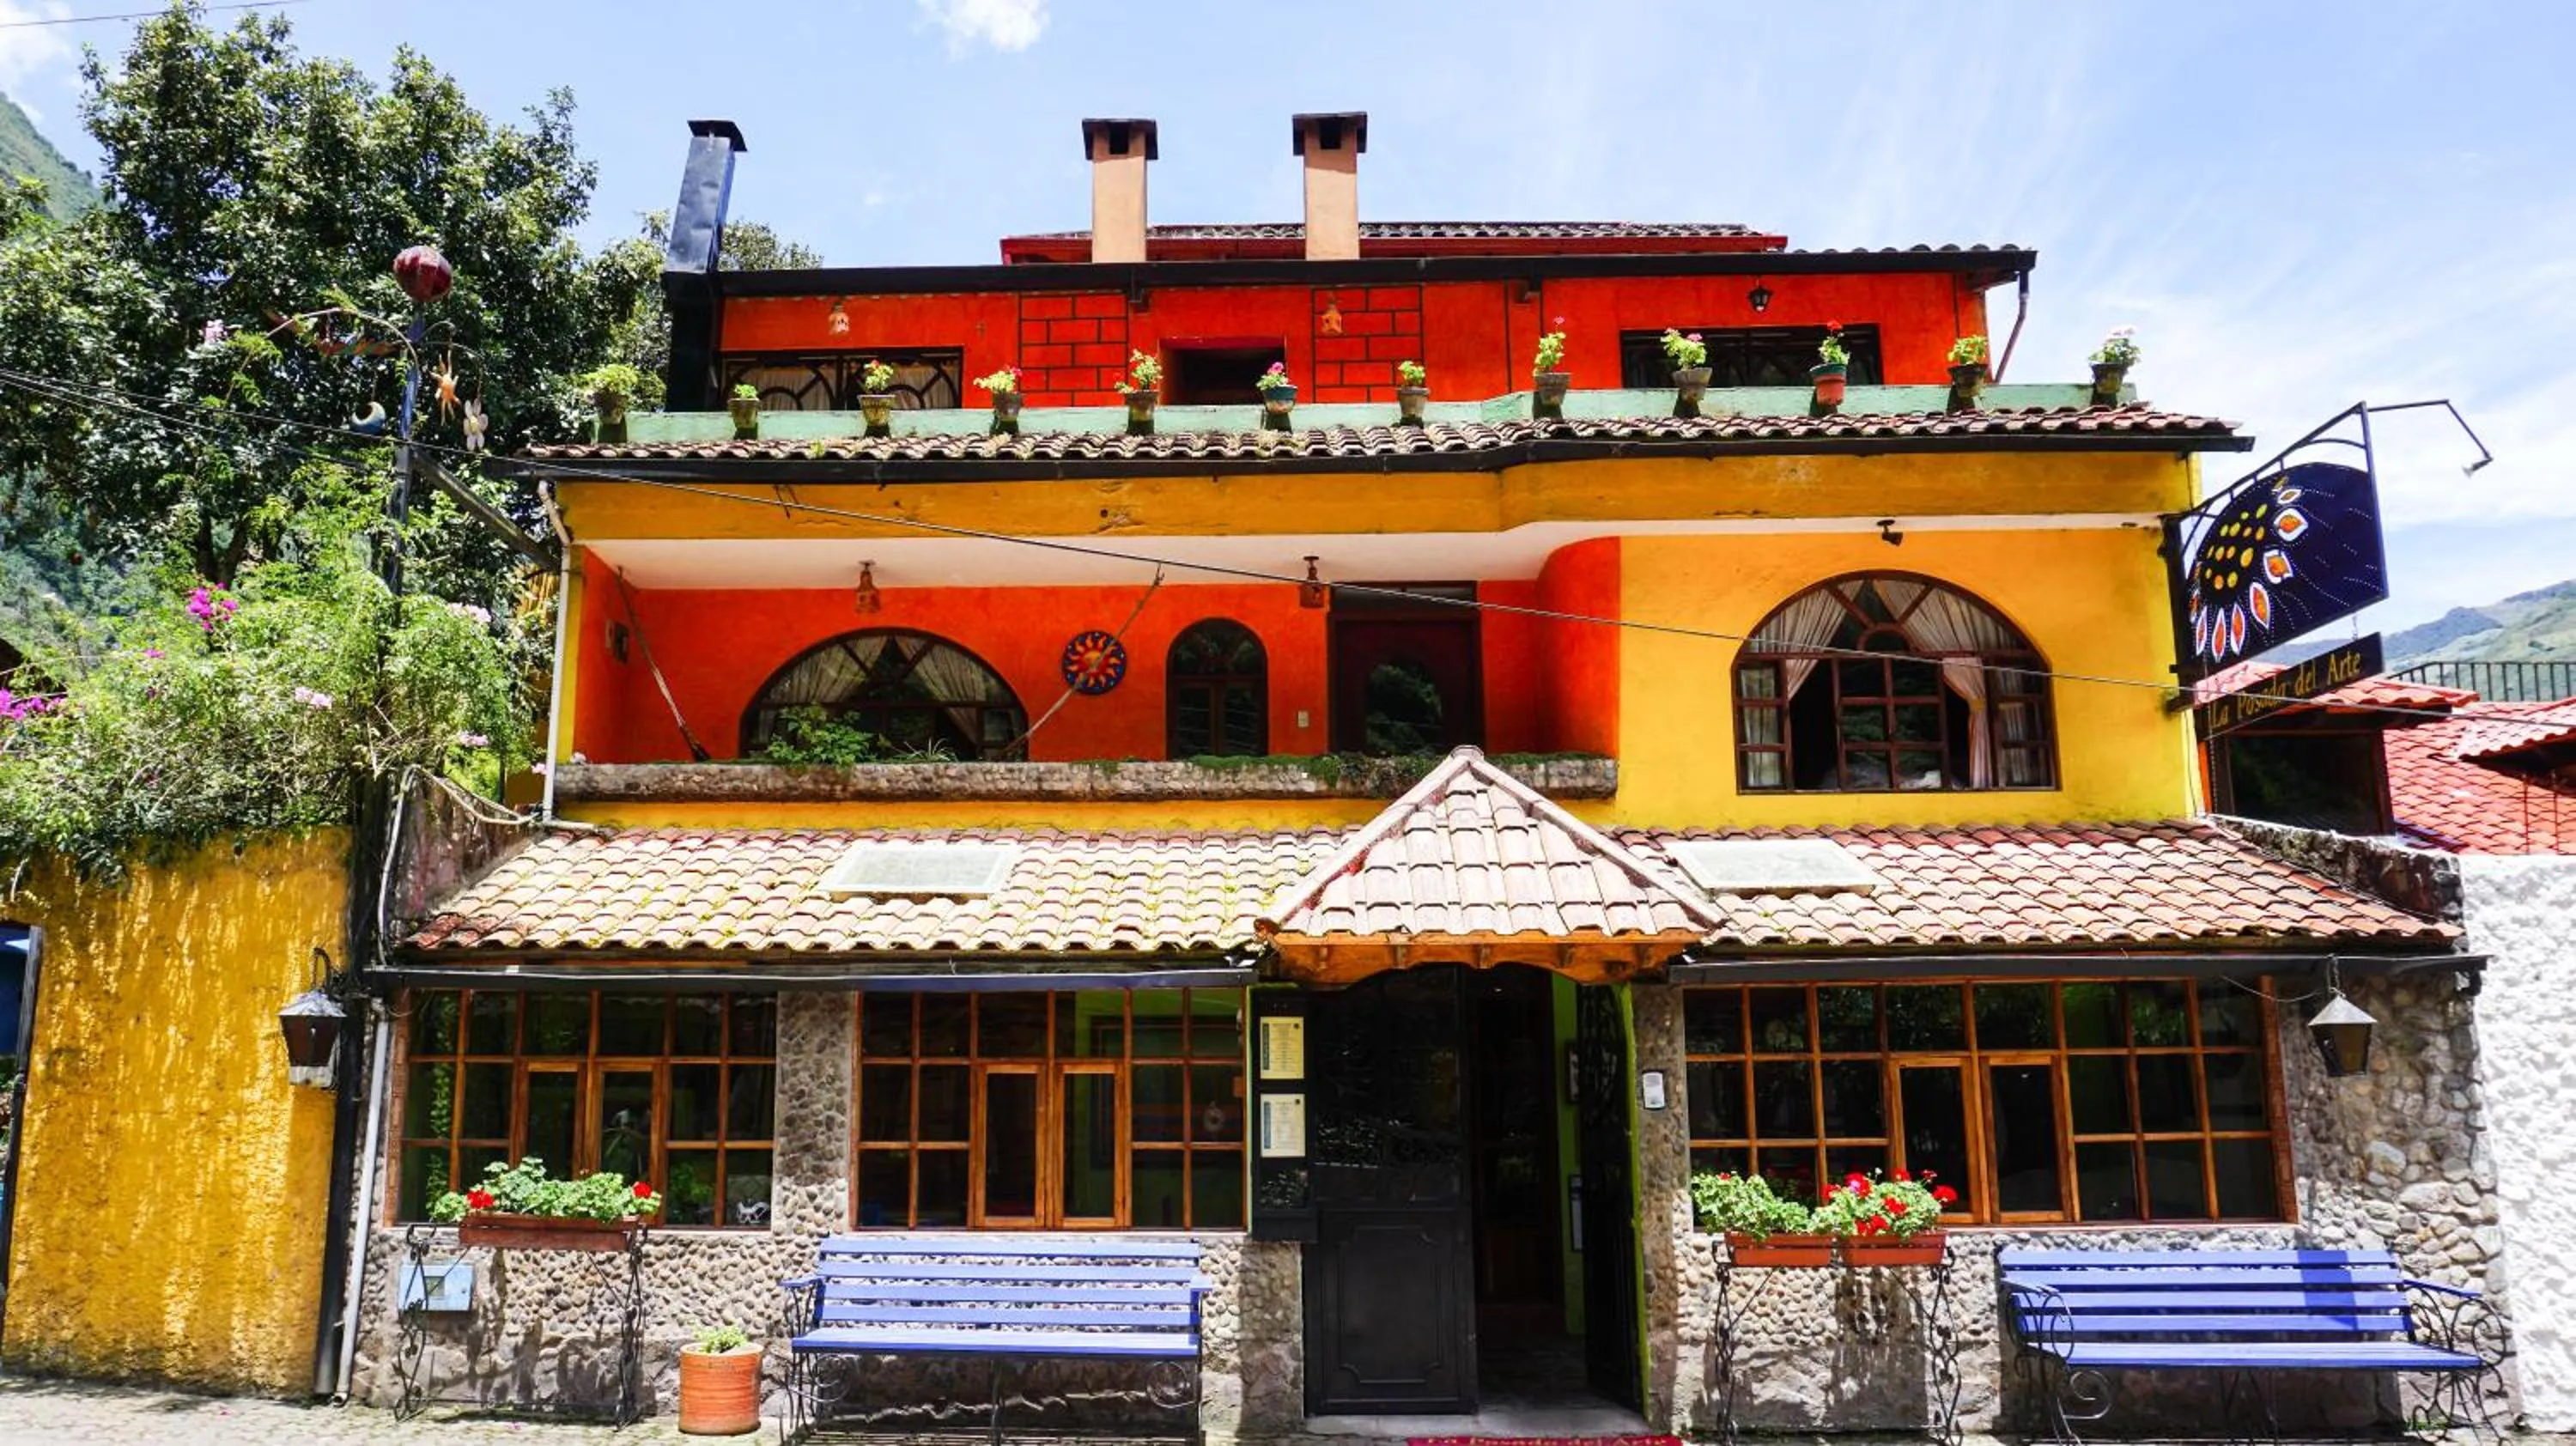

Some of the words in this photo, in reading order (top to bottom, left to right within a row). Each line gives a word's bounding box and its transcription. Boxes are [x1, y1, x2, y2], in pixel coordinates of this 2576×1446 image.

[2212, 702, 2229, 728] La
[2295, 660, 2316, 696] del
[2327, 650, 2361, 685] Arte
